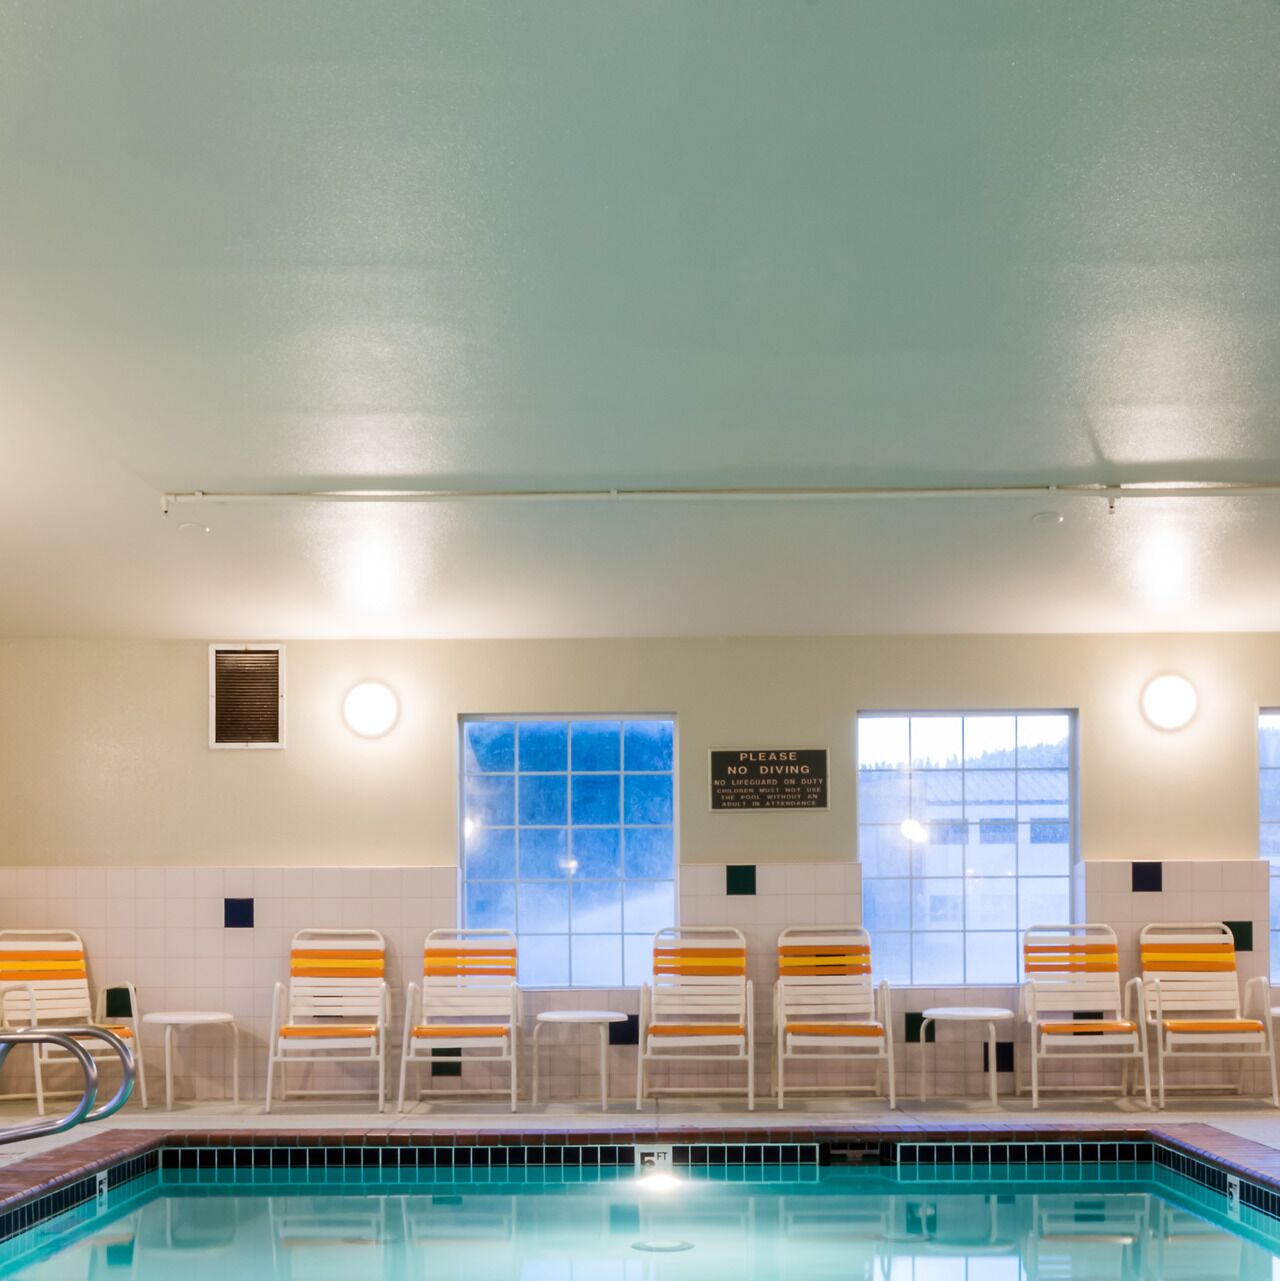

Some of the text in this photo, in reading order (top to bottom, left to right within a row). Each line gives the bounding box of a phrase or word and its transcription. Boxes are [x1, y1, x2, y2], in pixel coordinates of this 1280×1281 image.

[740, 752, 797, 761] PLEASE
[727, 765, 810, 775] NO DIVING
[640, 1151, 668, 1166] 5 FT
